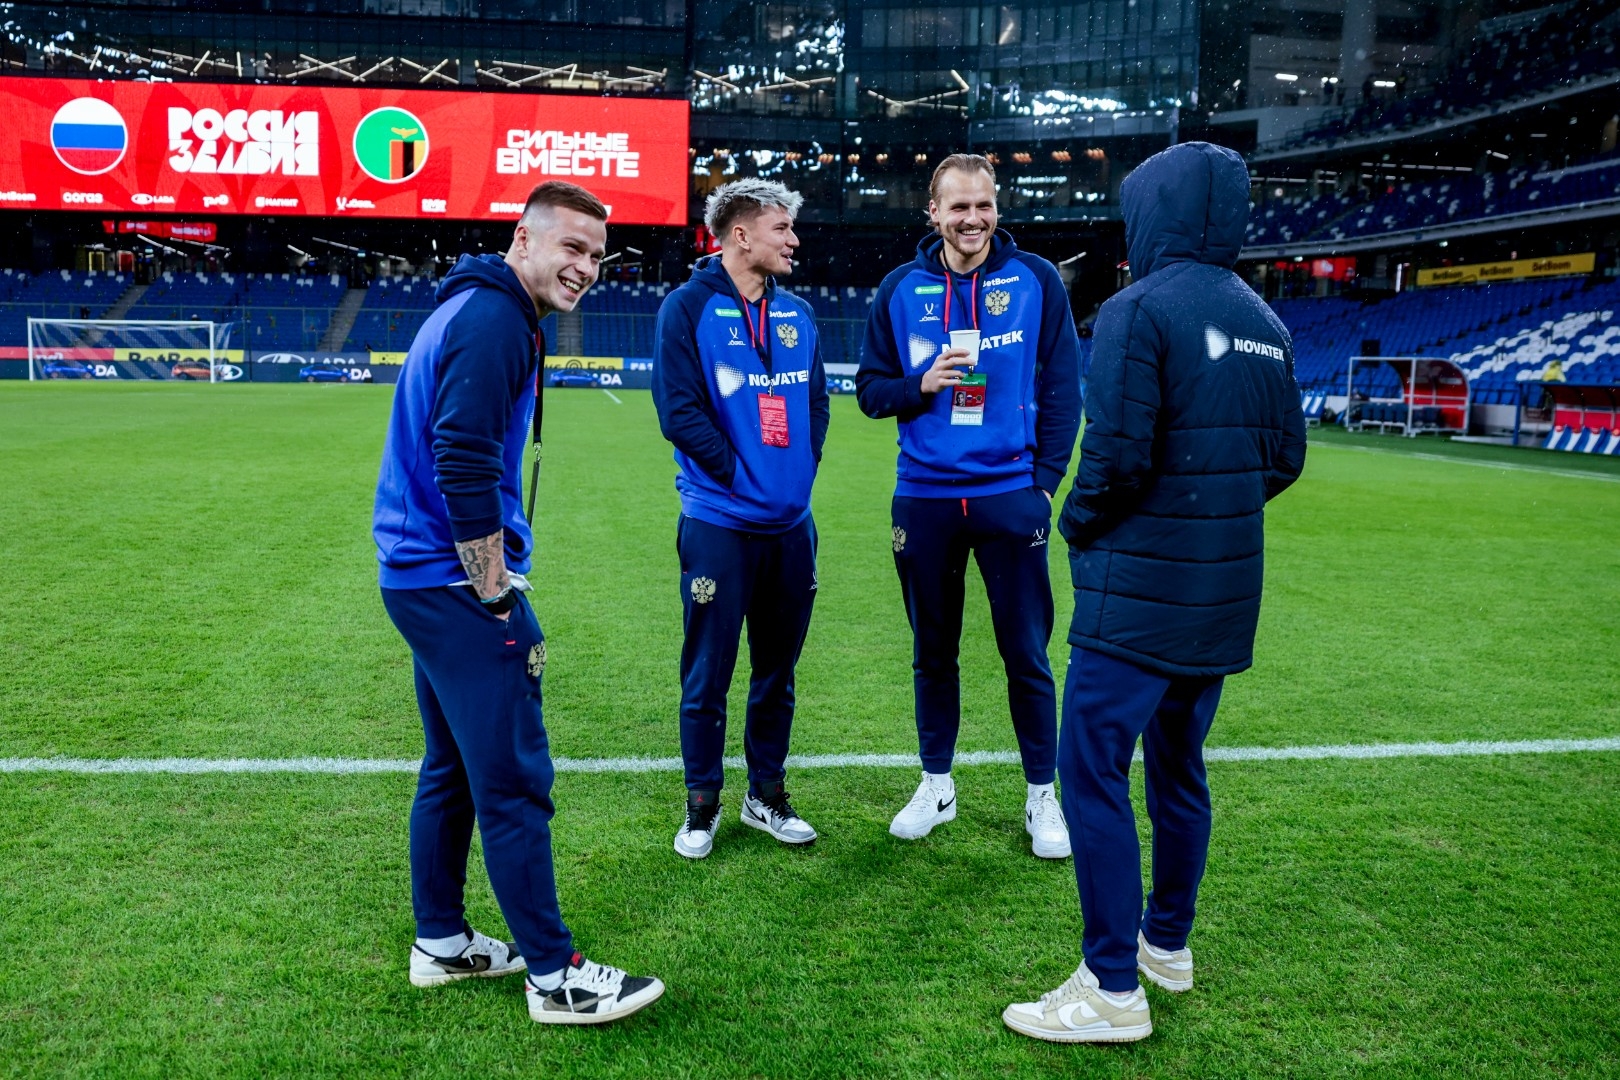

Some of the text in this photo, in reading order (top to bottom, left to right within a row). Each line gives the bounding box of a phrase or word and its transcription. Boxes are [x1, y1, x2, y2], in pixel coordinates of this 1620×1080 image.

[168, 107, 318, 143] РОССИЯ
[507, 129, 629, 152] СИЛЬНЫЕ
[496, 148, 640, 178] ВМЕСТЕ
[941, 330, 1024, 353] NATEK
